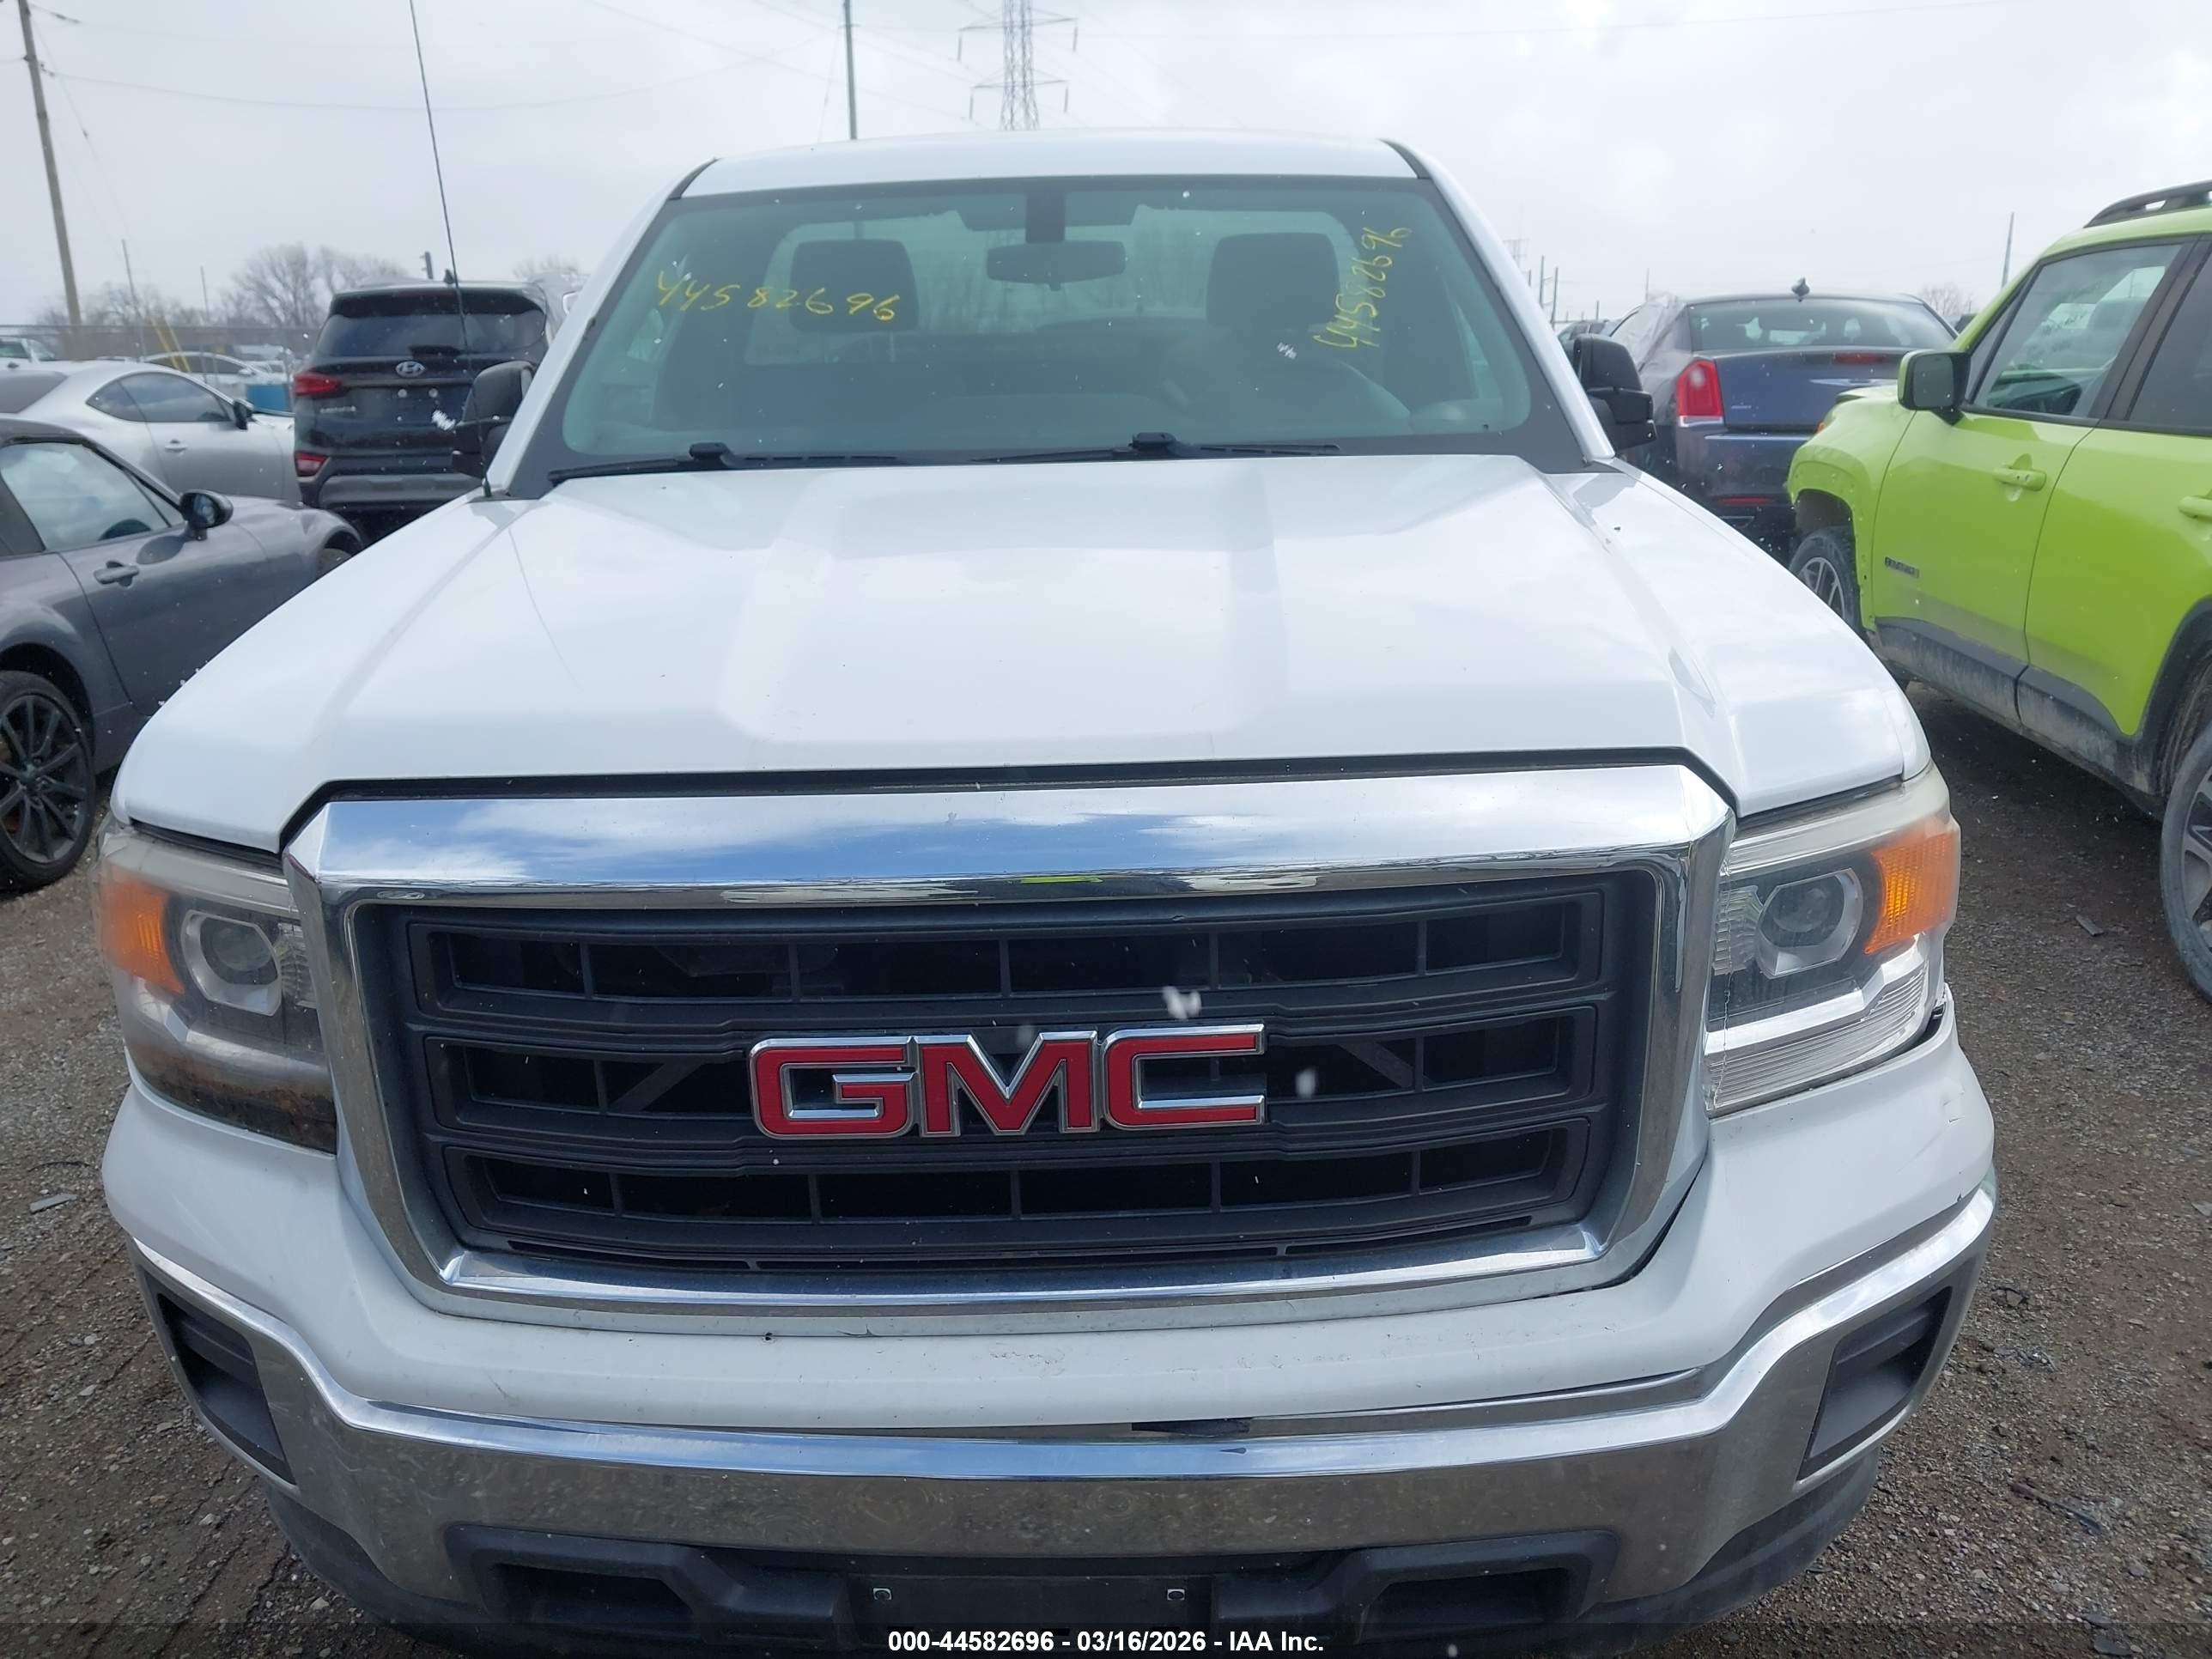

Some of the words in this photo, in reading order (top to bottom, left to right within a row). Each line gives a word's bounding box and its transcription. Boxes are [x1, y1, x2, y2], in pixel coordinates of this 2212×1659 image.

[657, 270, 902, 322] 44582696
[1311, 226, 1413, 349] 44582696
[749, 1024, 1266, 1139] GMC
